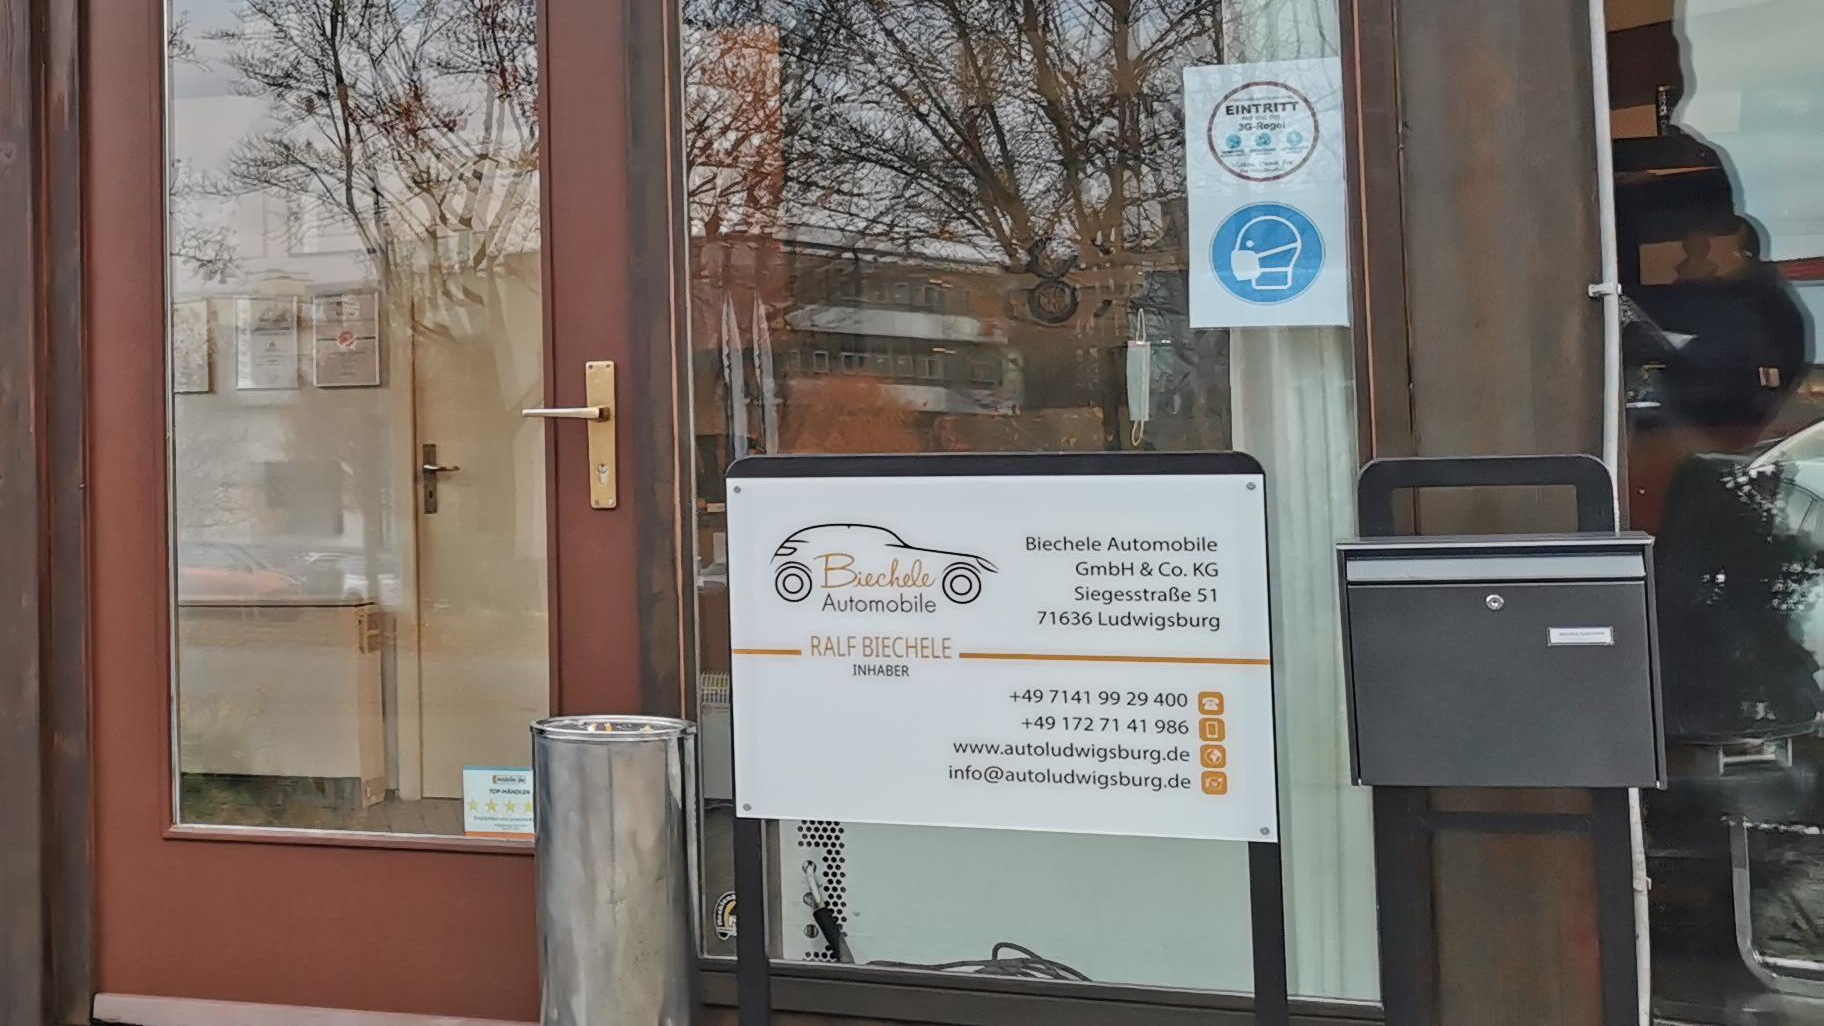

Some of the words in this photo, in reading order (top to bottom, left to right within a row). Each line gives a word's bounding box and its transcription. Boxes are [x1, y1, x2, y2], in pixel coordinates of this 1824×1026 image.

[1225, 101, 1299, 115] EINTRITT
[1025, 536, 1102, 552] Biechele
[1107, 536, 1218, 552] Automobile
[813, 553, 937, 589] Biechele
[1075, 561, 1135, 576] GmbH
[1139, 562, 1153, 577] &
[1158, 562, 1187, 577] Co.
[1193, 562, 1219, 577] KG
[821, 592, 937, 613] Automobile
[1074, 585, 1192, 605] Siegesstraße
[1197, 587, 1217, 602] 51
[1037, 611, 1093, 625] 71636
[1098, 611, 1220, 631] Ludwigsburg
[810, 635, 856, 657] RALF
[862, 636, 952, 659] BIECHELE
[852, 664, 910, 677] INHABER
[1009, 689, 1044, 704] +49
[1049, 690, 1091, 705] 7141
[1098, 691, 1121, 706] 99
[1126, 691, 1148, 707] 29
[1153, 692, 1188, 708] 400
[1021, 716, 1056, 730] +49
[1062, 717, 1094, 731] 172
[1099, 718, 1119, 732] 71
[1127, 718, 1147, 733] 41
[1154, 719, 1189, 734] 986
[953, 741, 1190, 764] www.autoludwigsburg.de
[948, 765, 1191, 792] info@autoludwigsburg.de
